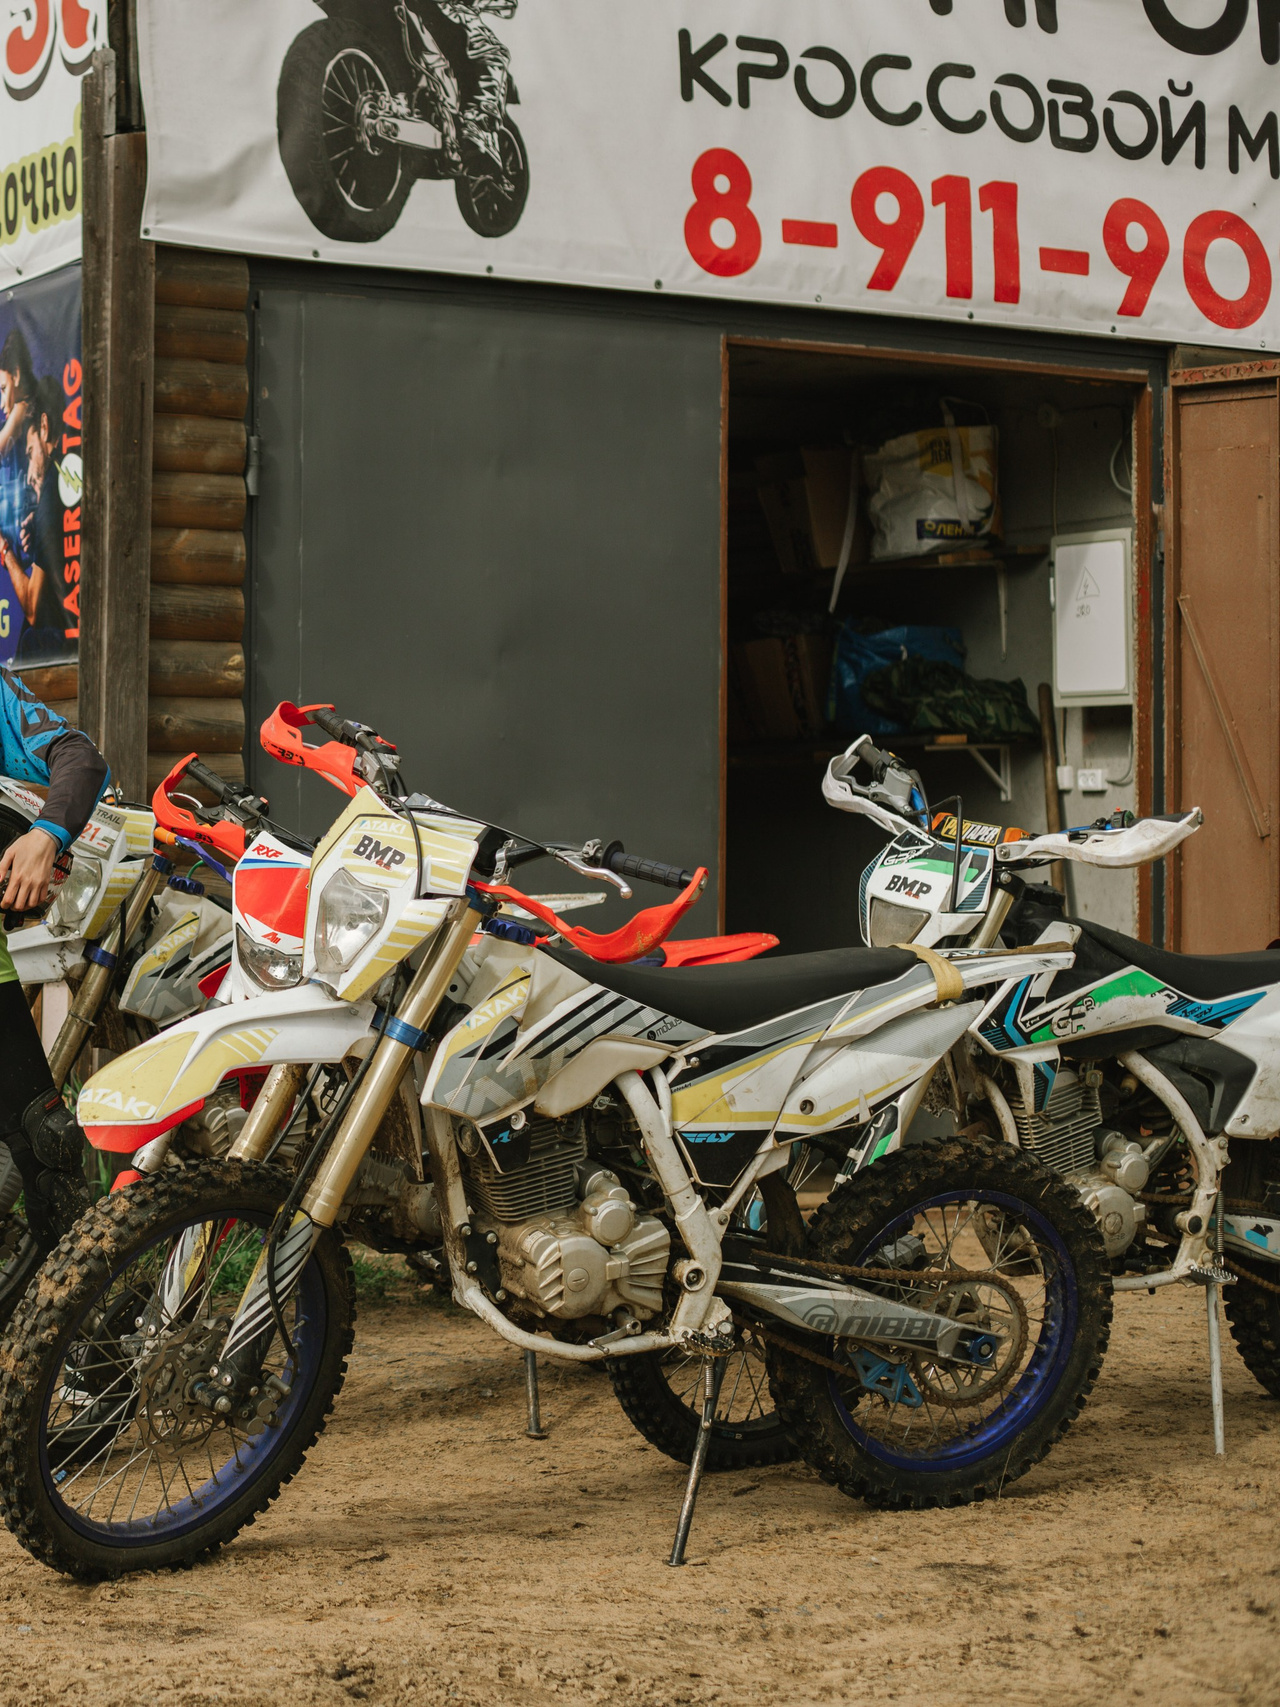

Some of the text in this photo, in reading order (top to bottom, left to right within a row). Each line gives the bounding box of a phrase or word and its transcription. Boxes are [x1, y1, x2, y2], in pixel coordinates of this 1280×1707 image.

[677, 28, 1207, 170] КРОССОВОЙ
[62, 358, 83, 639] LASER TAG
[96, 809, 121, 825] TRAIL
[360, 819, 407, 834] ATAKI
[251, 843, 284, 859] RXF
[465, 983, 529, 1031] ATAKI
[79, 1087, 157, 1120] ATAKI
[681, 1132, 736, 1143] FLY
